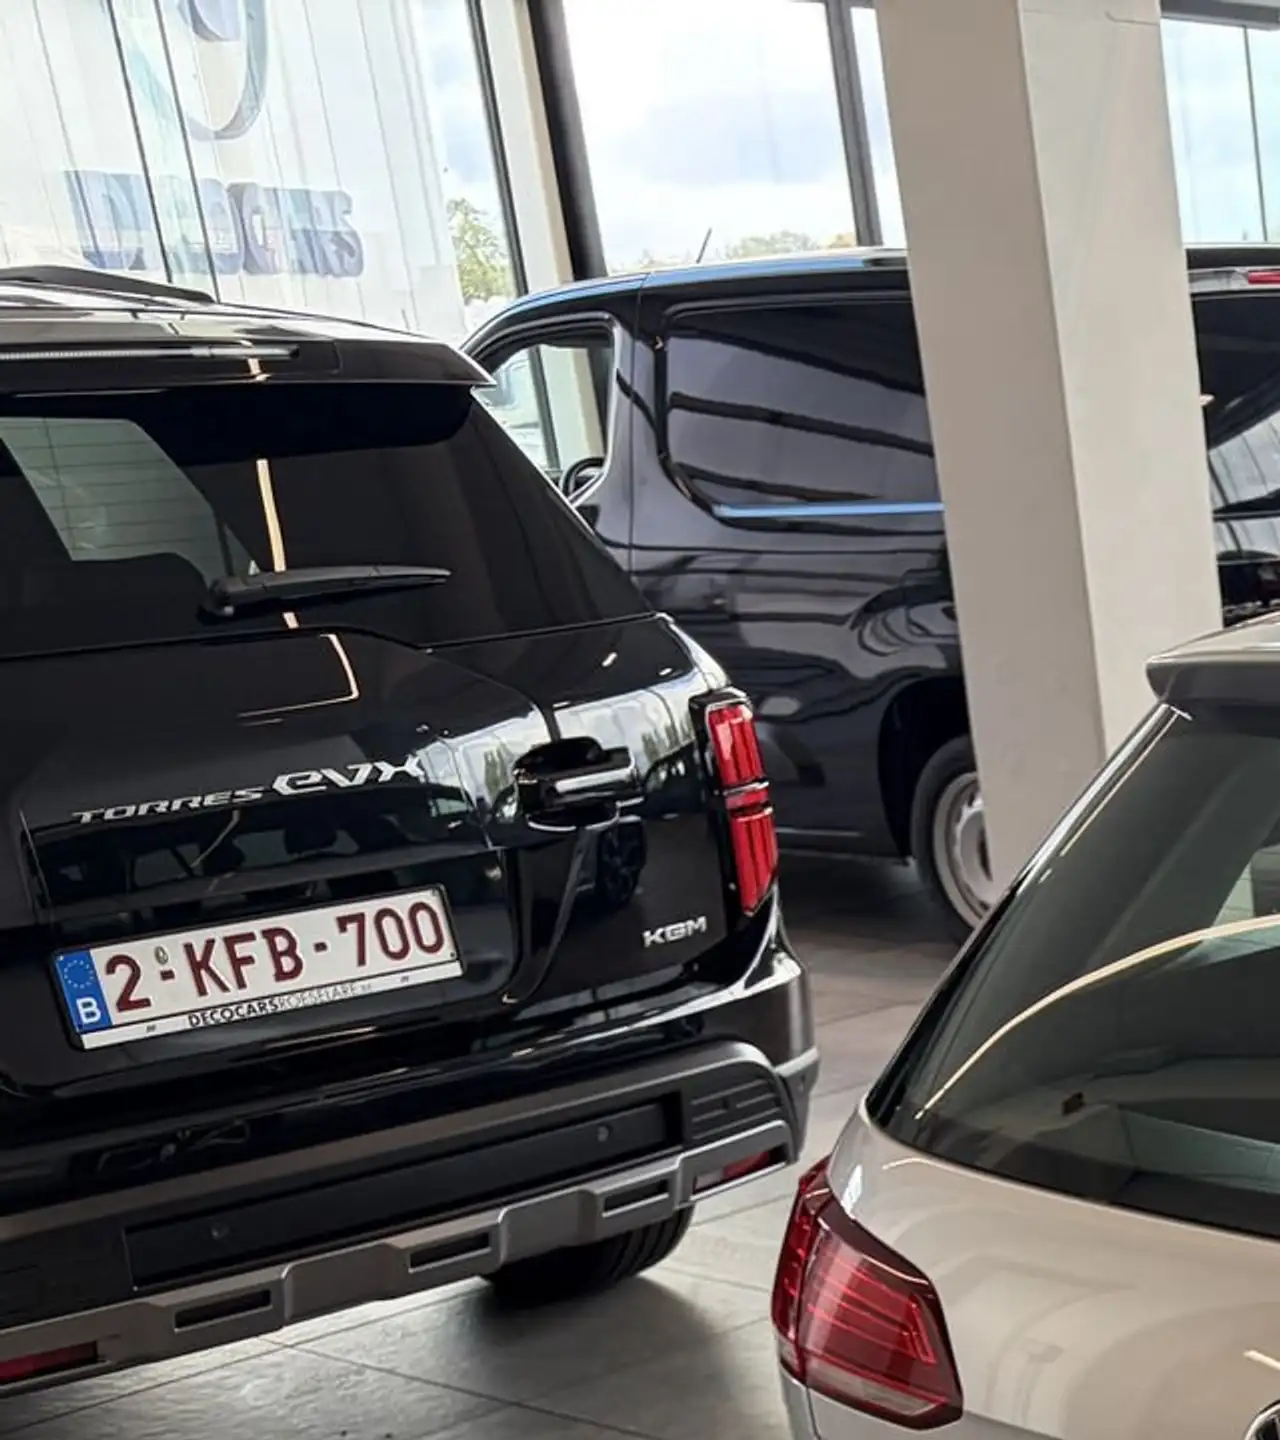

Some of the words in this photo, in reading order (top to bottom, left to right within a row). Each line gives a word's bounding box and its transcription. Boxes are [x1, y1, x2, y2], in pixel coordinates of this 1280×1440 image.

[72, 787, 264, 824] TORRES
[642, 915, 707, 948] KGM
[104, 901, 445, 1013] 2-KFB-700
[75, 997, 101, 1025] B
